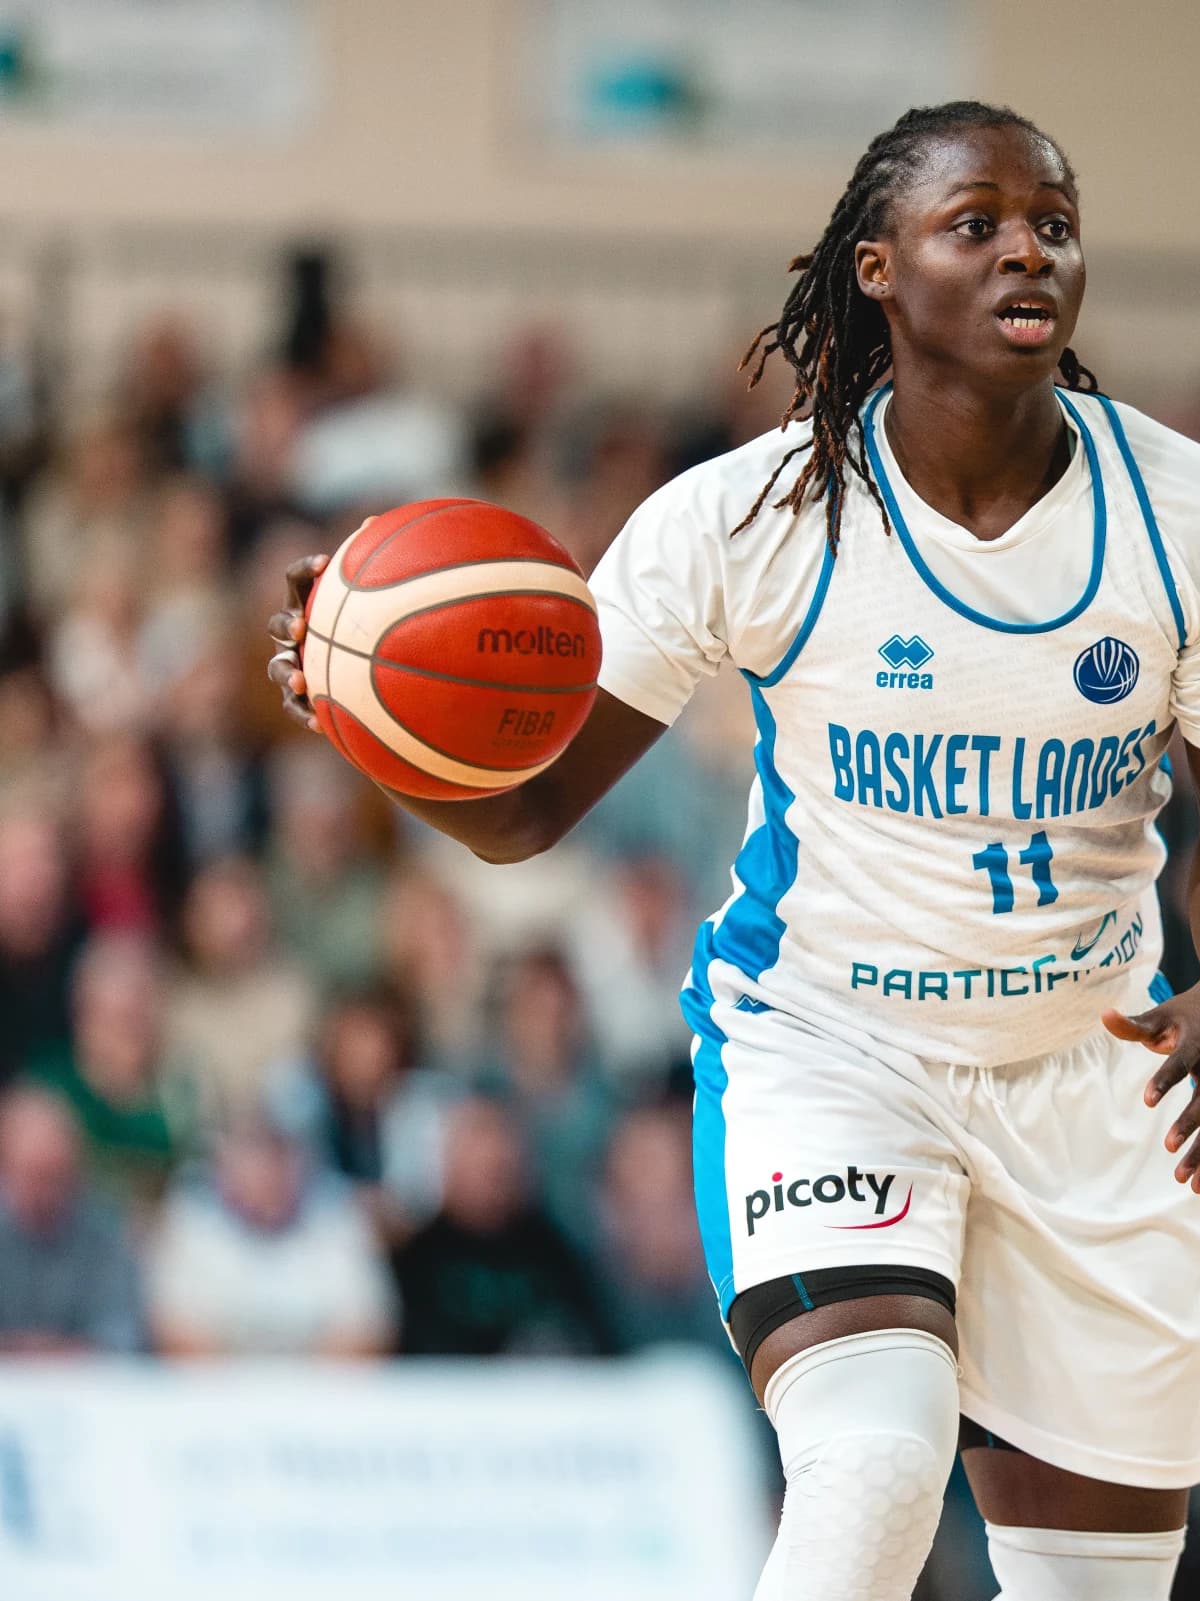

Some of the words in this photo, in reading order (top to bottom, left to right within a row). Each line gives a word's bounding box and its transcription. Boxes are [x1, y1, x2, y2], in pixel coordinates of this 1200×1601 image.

[477, 625, 585, 658] molten
[876, 671, 933, 689] errea
[498, 708, 555, 736] FIBA
[828, 722, 1000, 818] BASKET
[1012, 719, 1156, 819] LANDES
[973, 831, 1059, 914] 11
[851, 911, 1143, 1001] PARTICIPTION
[746, 1166, 896, 1236] picoty
